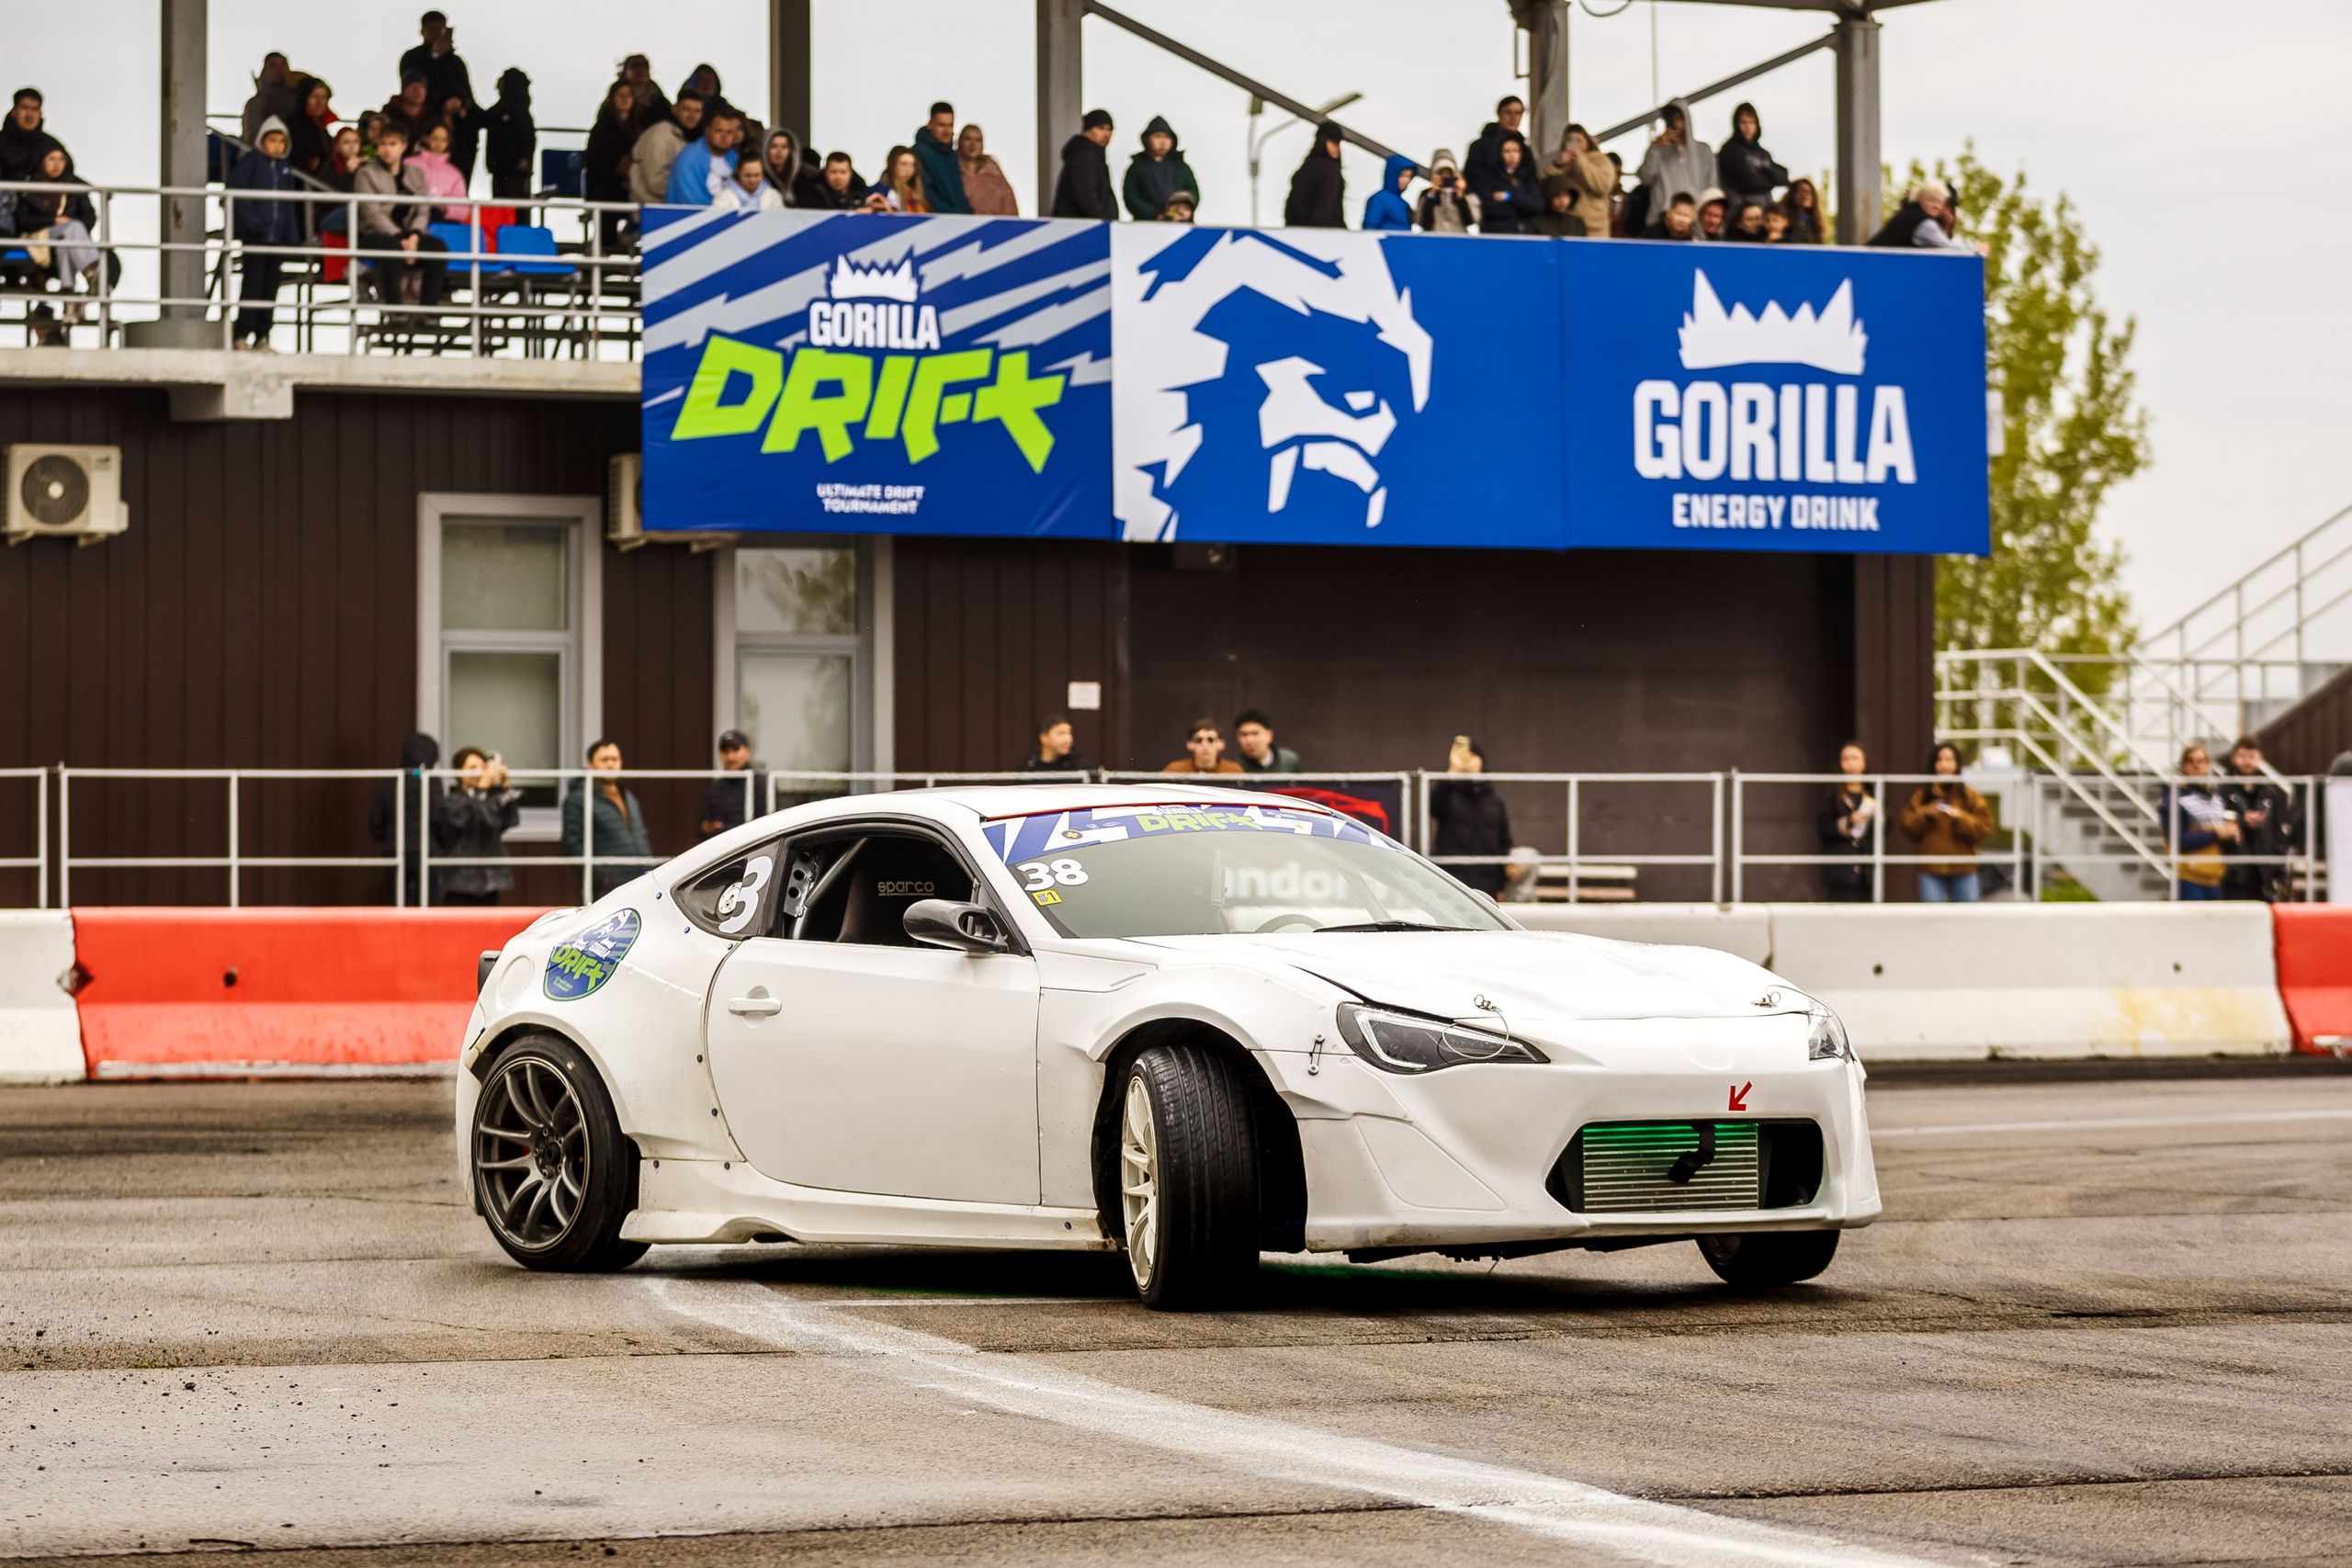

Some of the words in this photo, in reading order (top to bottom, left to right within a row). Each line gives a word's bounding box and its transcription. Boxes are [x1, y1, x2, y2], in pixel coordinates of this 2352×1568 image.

[809, 302, 941, 350] GORILLA
[671, 334, 1066, 474] DRIFT
[1634, 379, 1917, 484] GORILLA
[817, 482, 883, 499] ULTIMATE
[884, 484, 926, 501] DRIFT
[821, 497, 920, 514] TOURNAMENT
[1672, 493, 1786, 530] ENERGY
[1791, 494, 1881, 532] DRINK
[1136, 812, 1263, 833] DRIFT
[877, 880, 934, 897] sparco
[1016, 858, 1089, 891] 38
[718, 855, 773, 934] 3
[550, 943, 605, 992] DRIFT
